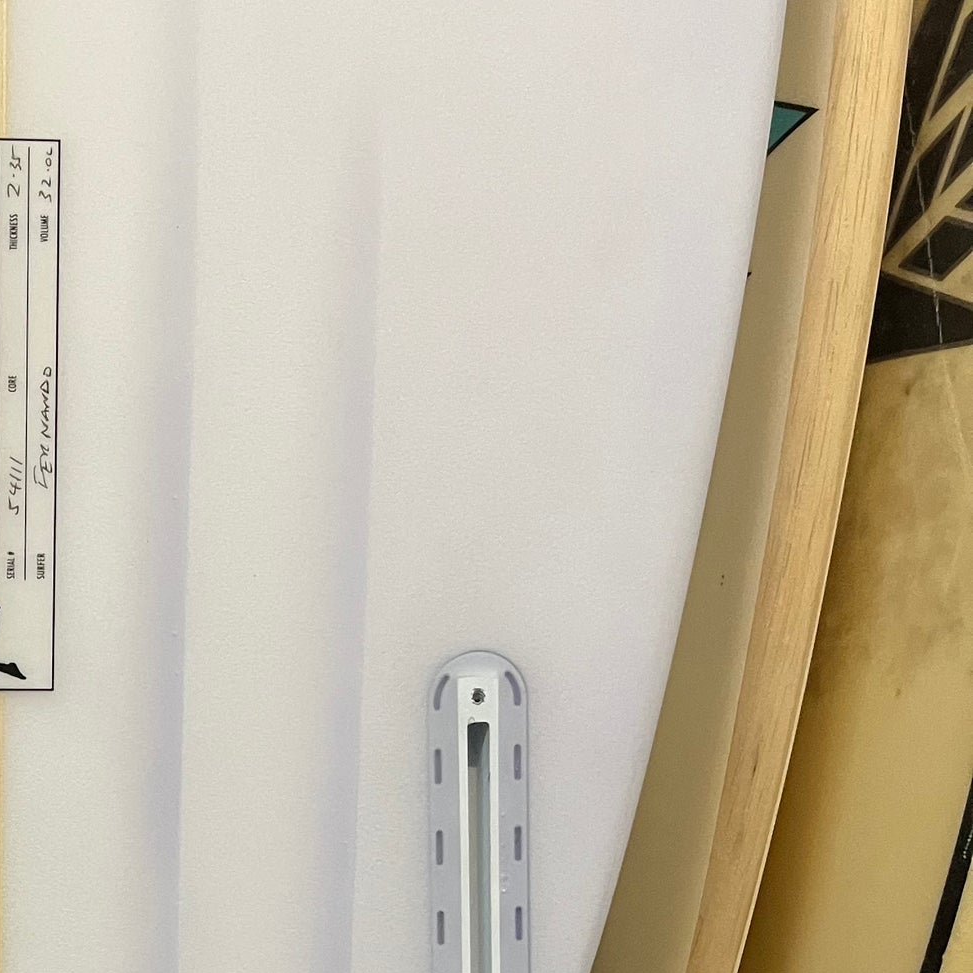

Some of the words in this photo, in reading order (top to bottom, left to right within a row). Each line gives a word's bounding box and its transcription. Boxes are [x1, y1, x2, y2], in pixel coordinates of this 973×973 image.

[7, 145, 21, 197] 2.35
[9, 214, 18, 249] THICKNESS
[40, 214, 49, 242] VOLUME
[8, 375, 17, 393] CORE
[9, 457, 22, 515] 54111
[7, 558, 15, 580] SERIAL
[37, 553, 46, 580] SURFER
